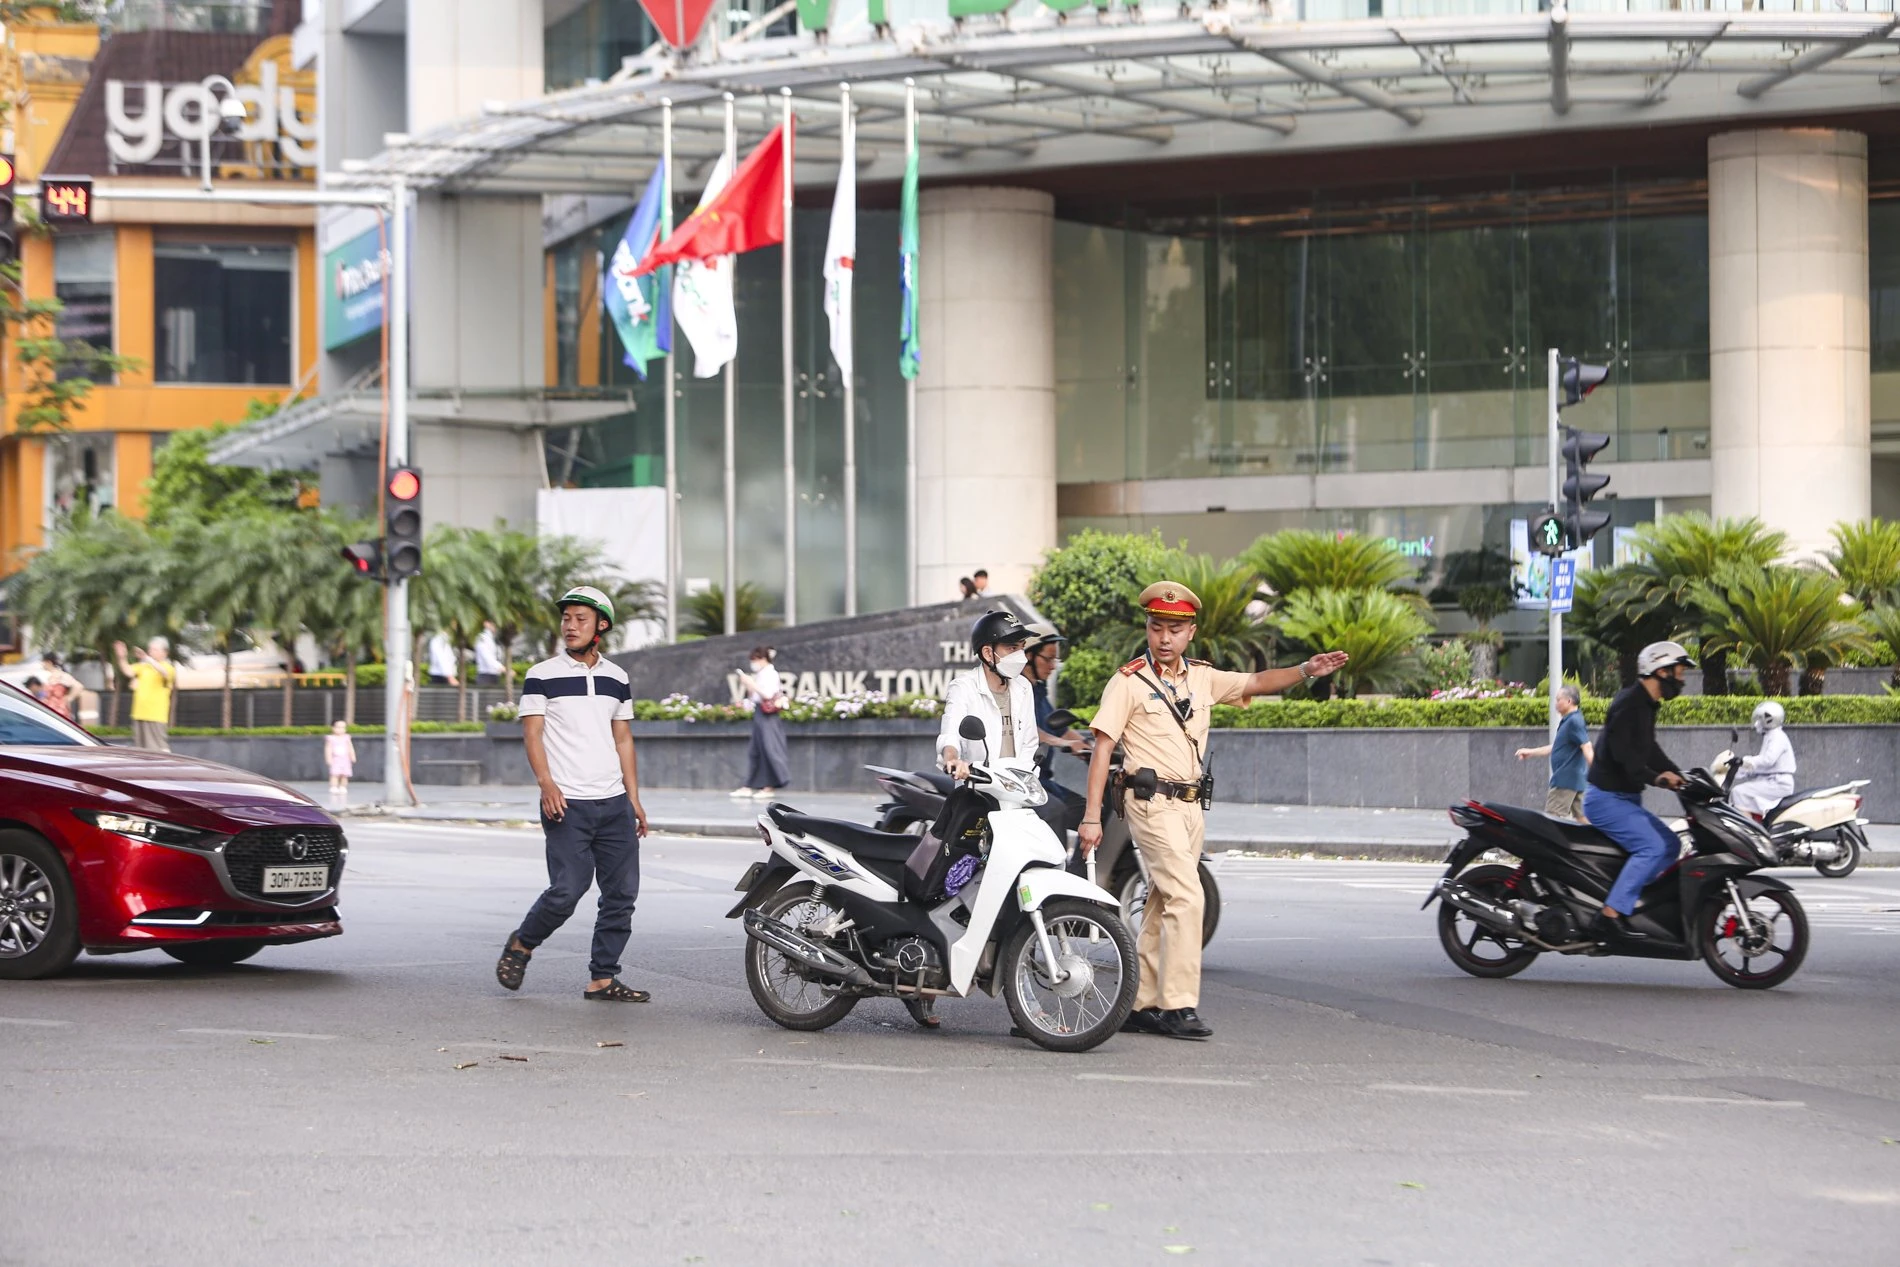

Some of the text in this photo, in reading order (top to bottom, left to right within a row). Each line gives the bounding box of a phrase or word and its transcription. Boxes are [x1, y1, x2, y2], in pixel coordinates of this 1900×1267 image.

[105, 59, 317, 164] yody
[48, 186, 87, 215] 44
[939, 641, 977, 662] TH
[726, 670, 867, 701] VBANK
